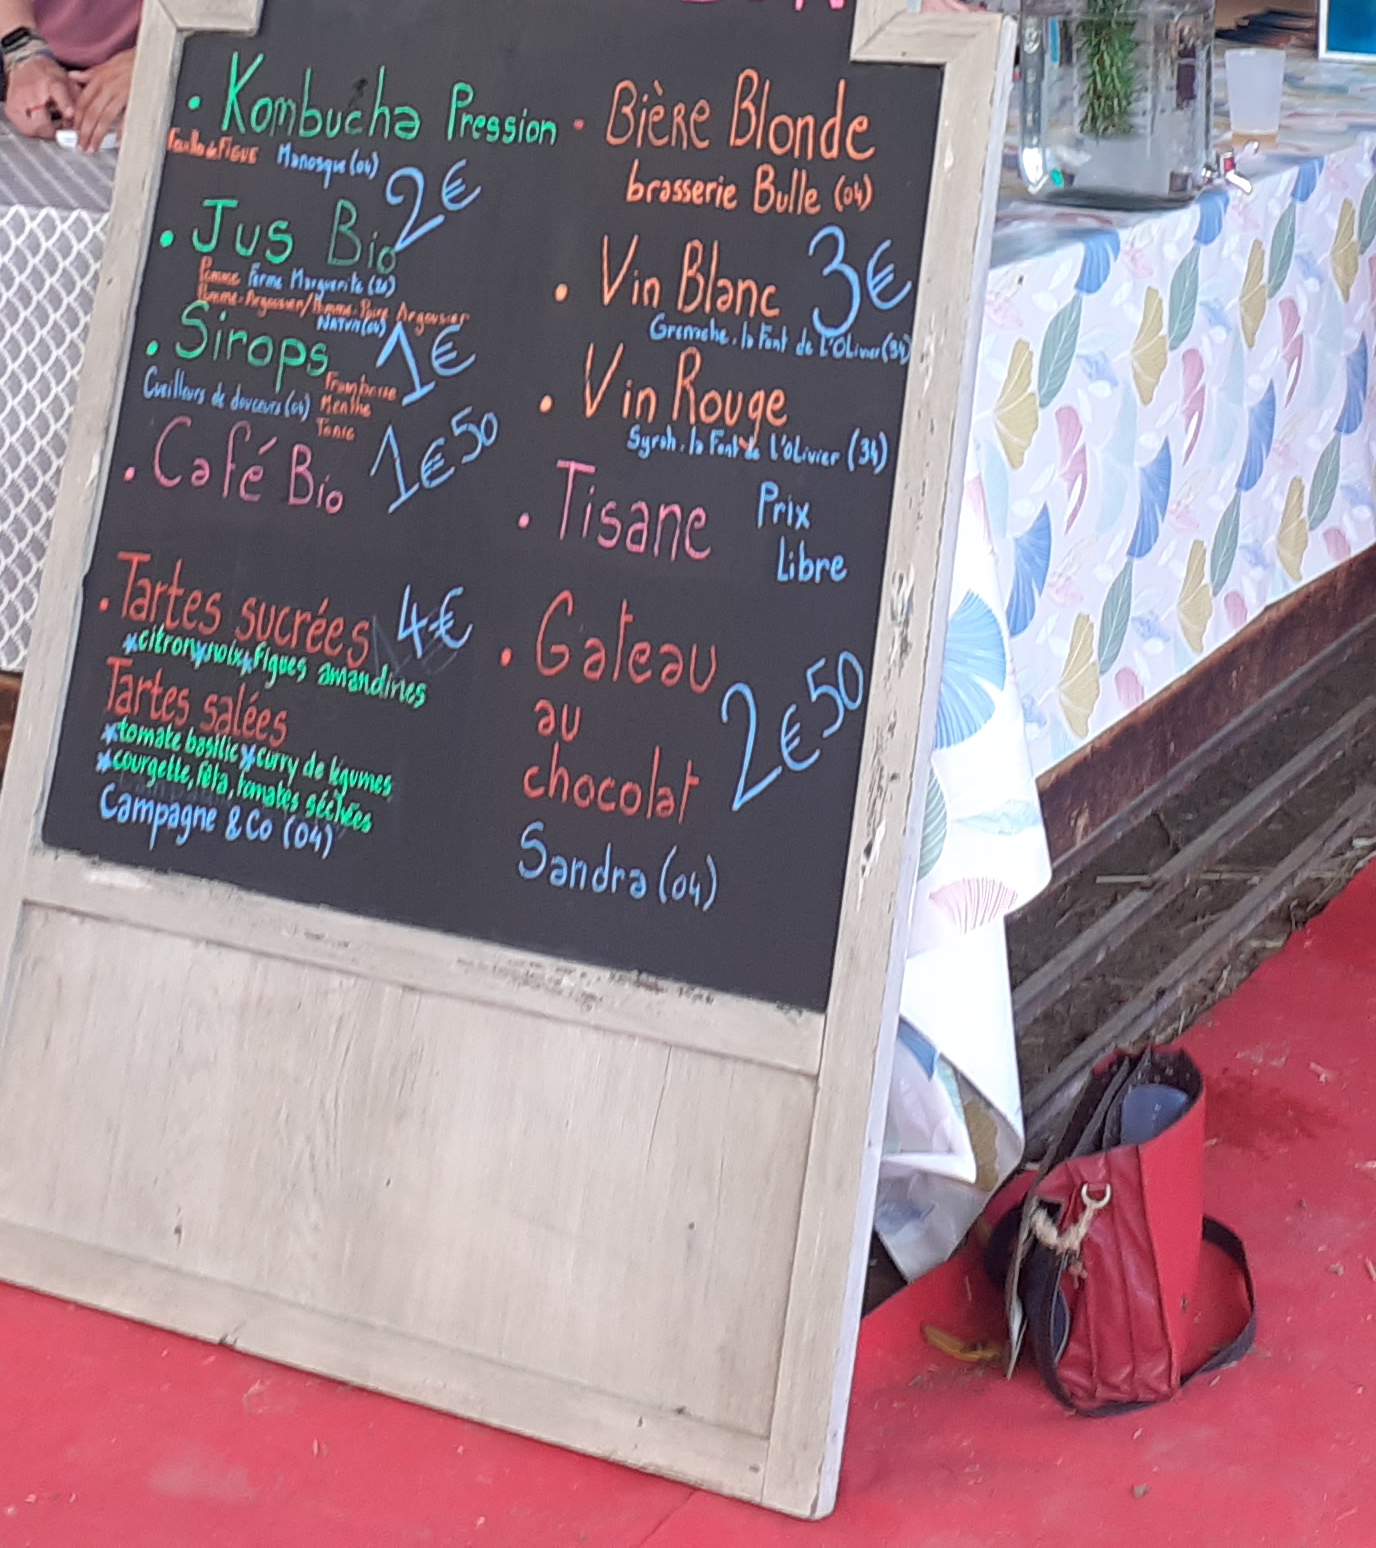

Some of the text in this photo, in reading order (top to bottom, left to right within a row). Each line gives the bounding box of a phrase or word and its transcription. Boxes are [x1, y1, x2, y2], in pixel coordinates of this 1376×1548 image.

[222, 52, 557, 146] Kombucha Pression
[729, 68, 876, 161] Blonde
[386, 159, 482, 252] 2€
[627, 158, 874, 215] brasserie Bulle (04)
[192, 198, 398, 274] Jus Bio
[601, 234, 781, 319] Vin Blanc
[808, 225, 913, 337] 3€
[175, 300, 330, 394] Sirops
[375, 319, 476, 407] 1€
[319, 392, 372, 419] Menthe
[584, 342, 789, 449] Vin Rouge
[153, 415, 345, 514] Café Bio
[756, 481, 811, 530] Prix
[555, 458, 712, 562] Tisane
[777, 536, 849, 584] Libre
[116, 550, 370, 670] Tartes sucrées
[396, 583, 474, 660] 4€
[535, 589, 718, 695] Gateau
[106, 655, 289, 748] Tartes salées
[318, 660, 428, 709] amandines
[533, 698, 582, 742] au
[117, 716, 181, 751] tomate
[185, 727, 239, 763] basilic
[256, 746, 300, 787] curry
[302, 750, 324, 780] de
[720, 650, 865, 812] 2€50
[99, 782, 218, 851] Campagne
[283, 814, 334, 859] (04)
[236, 770, 300, 813] tomates
[523, 740, 701, 825] chocolat
[518, 820, 719, 912] Sandra (04)
